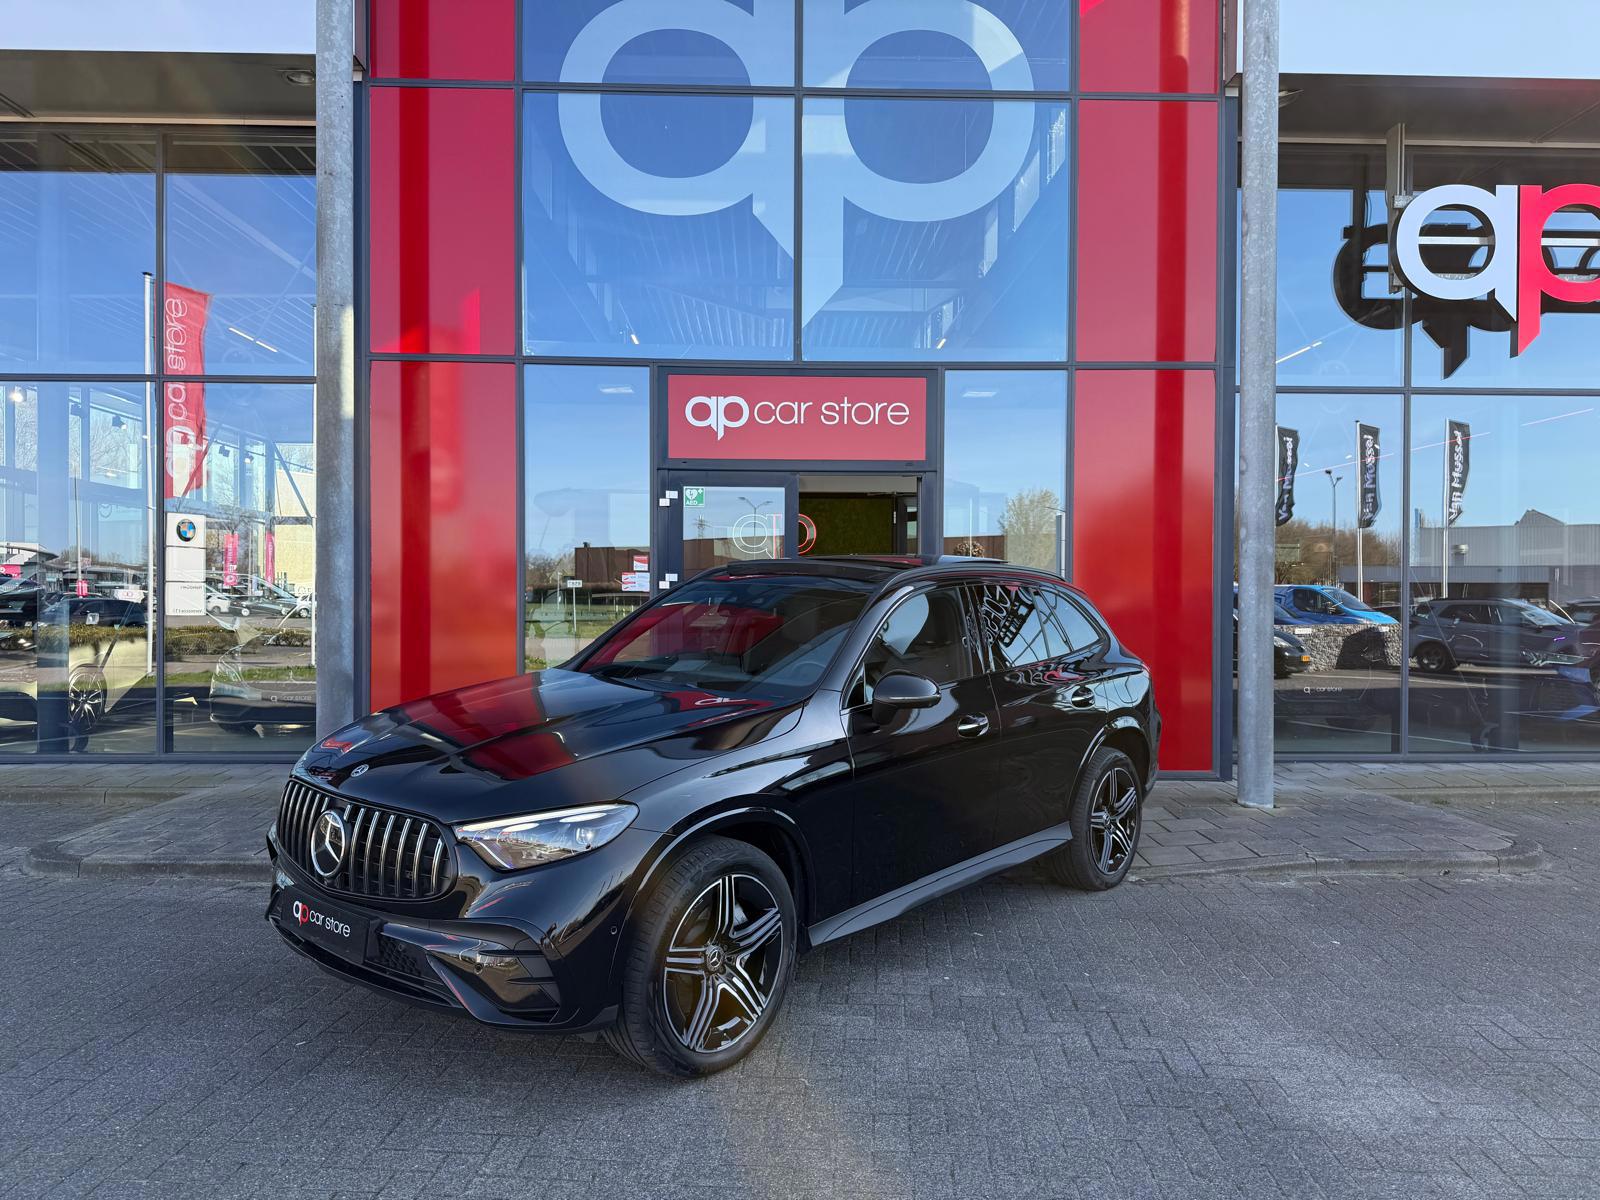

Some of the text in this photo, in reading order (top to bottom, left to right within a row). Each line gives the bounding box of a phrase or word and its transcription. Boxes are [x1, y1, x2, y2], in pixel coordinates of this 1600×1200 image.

[164, 298, 188, 371] store
[168, 382, 188, 421] ca
[685, 396, 910, 441] ap car store
[293, 900, 351, 937] ap car store
